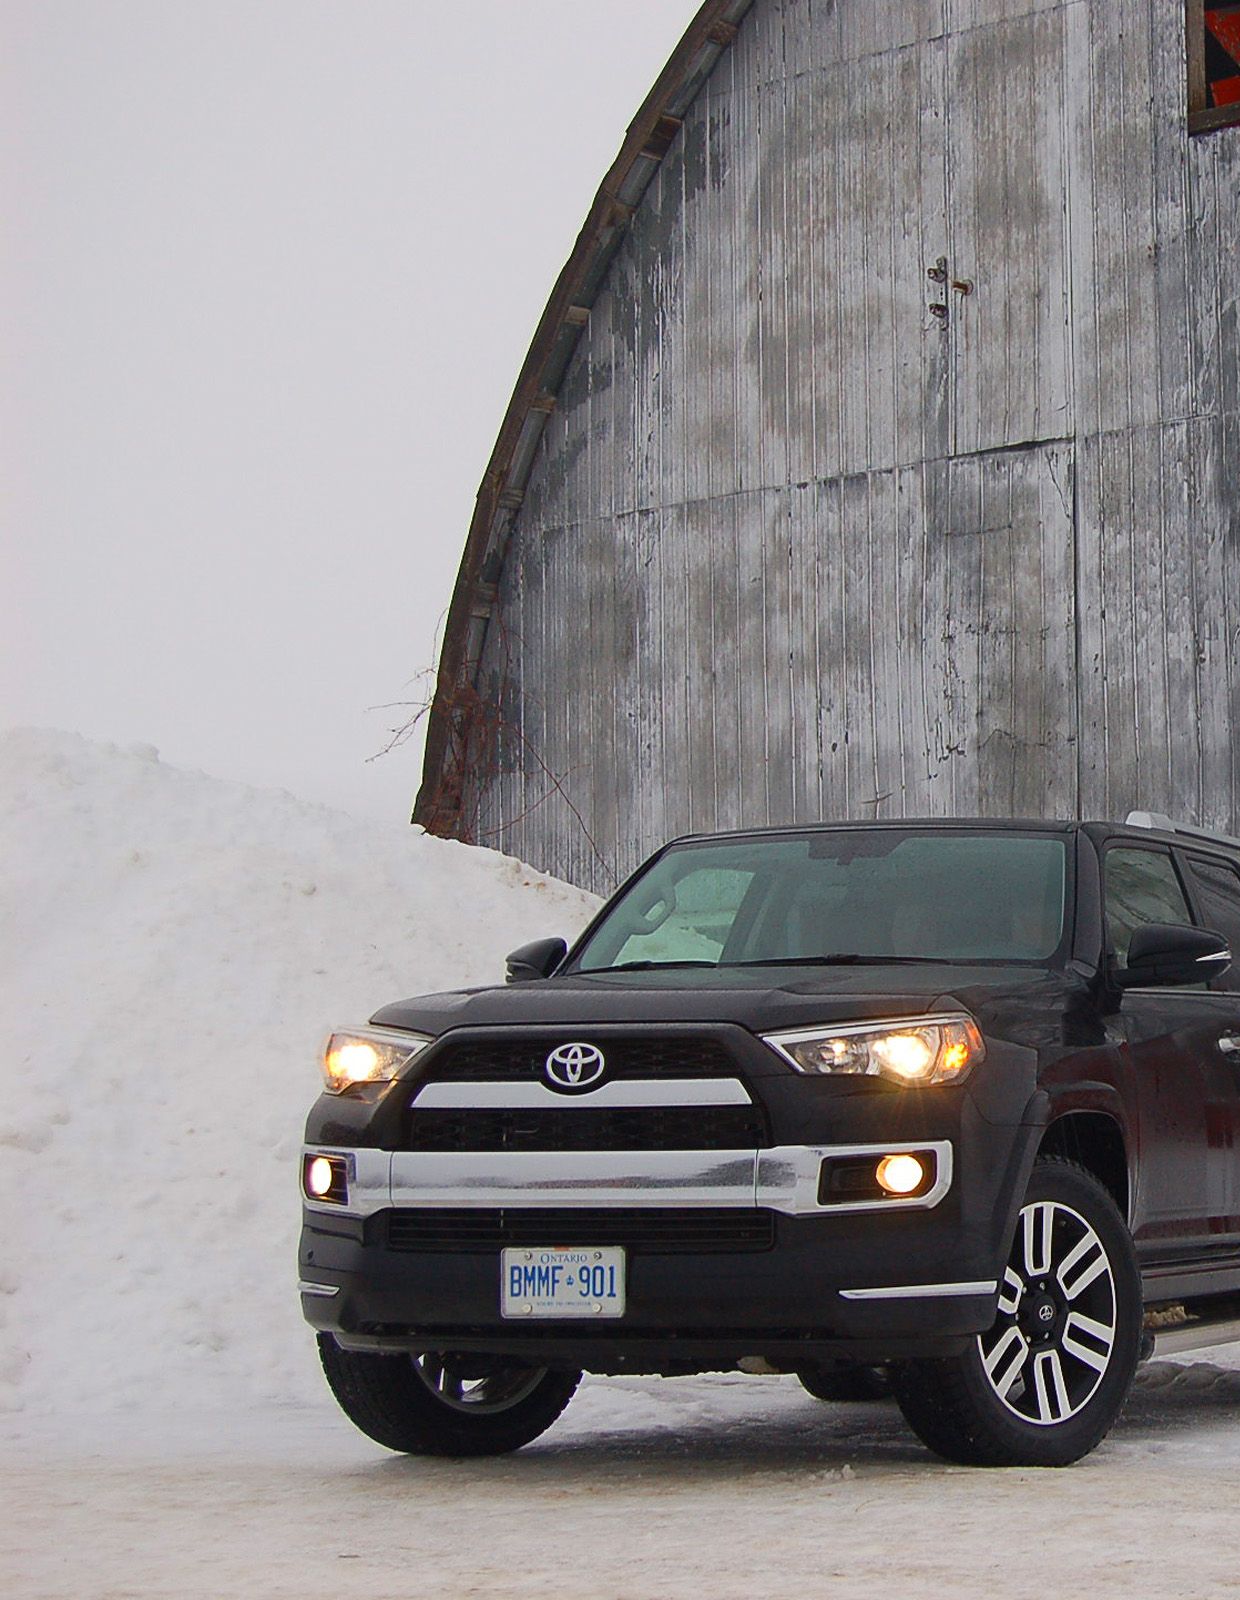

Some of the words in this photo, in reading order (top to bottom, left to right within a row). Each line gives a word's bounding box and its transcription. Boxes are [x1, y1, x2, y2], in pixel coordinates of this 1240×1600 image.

[540, 1253, 588, 1264] ONTARIO
[510, 1265, 563, 1297] BMMF
[579, 1265, 616, 1297] 901
